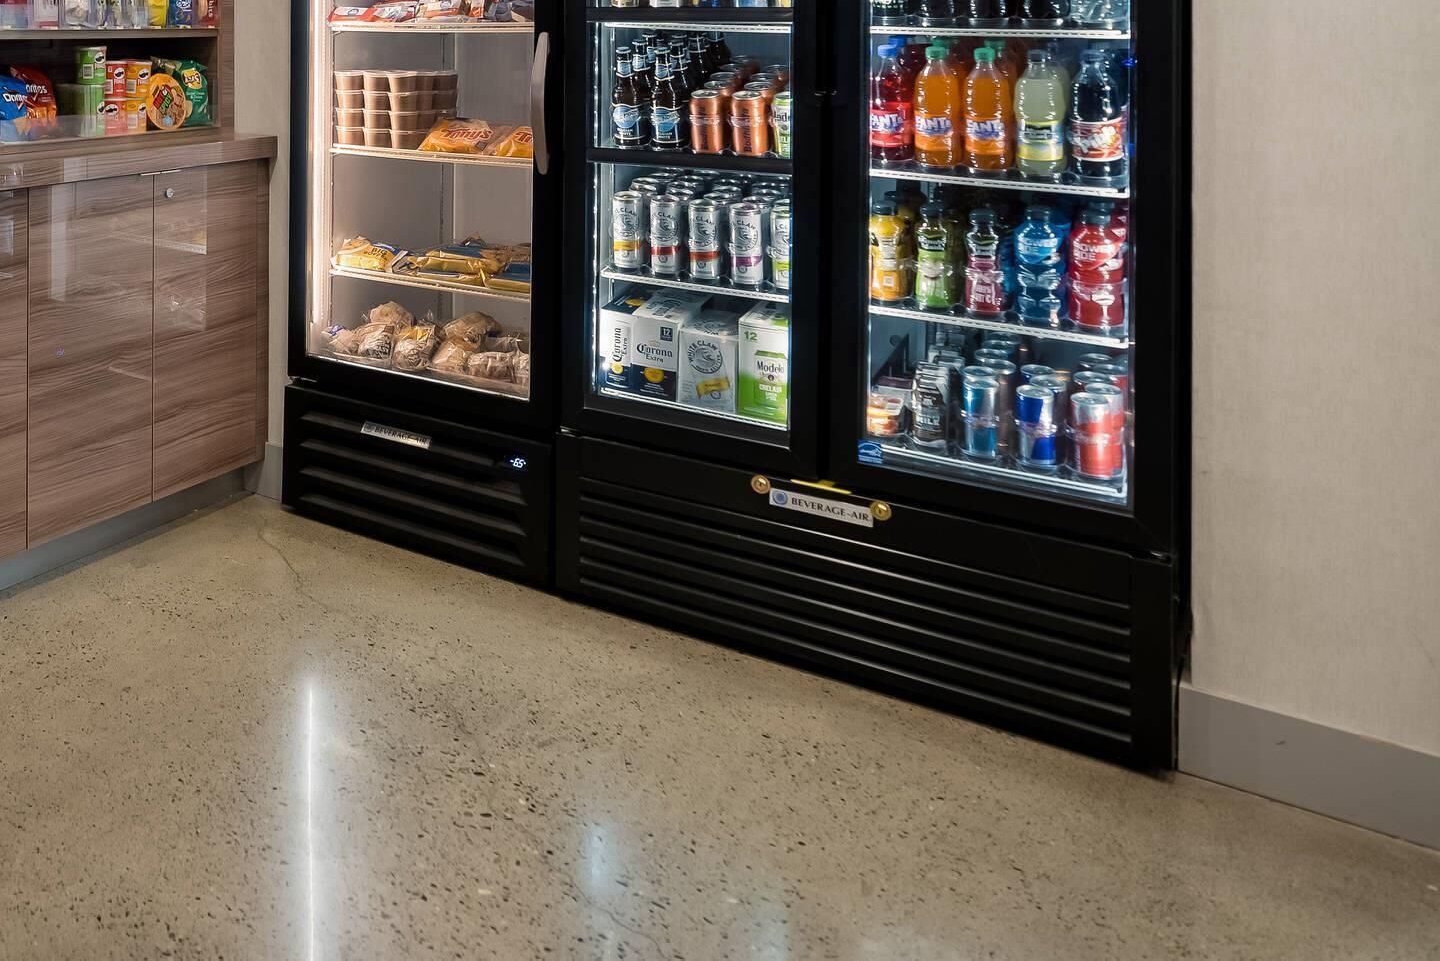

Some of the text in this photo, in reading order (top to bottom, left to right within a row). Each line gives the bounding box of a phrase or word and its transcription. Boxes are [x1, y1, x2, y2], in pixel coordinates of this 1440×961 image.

[663, 327, 671, 336] 12
[743, 330, 758, 341] 12
[612, 328, 622, 362] Corona
[636, 342, 673, 358] Corona
[688, 340, 718, 363] WHITE CLAW
[645, 351, 664, 363] Extra
[756, 360, 785, 375] Modelo
[791, 496, 870, 522] BEVERAGE-AIR
